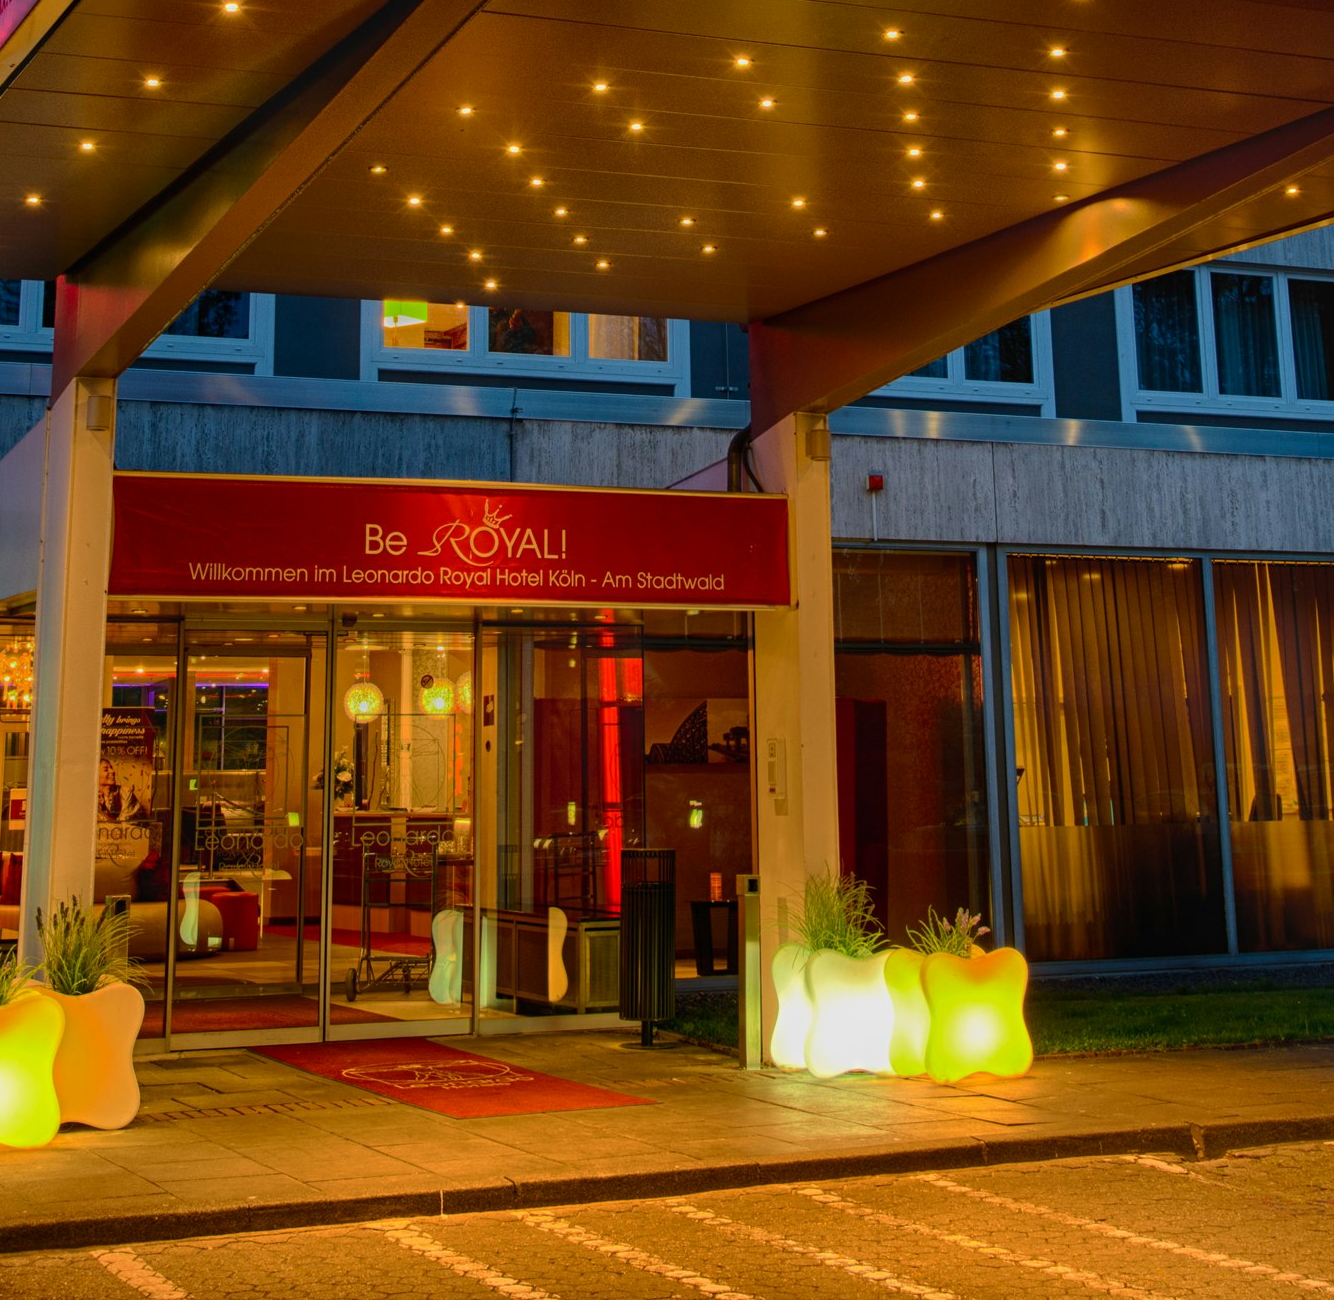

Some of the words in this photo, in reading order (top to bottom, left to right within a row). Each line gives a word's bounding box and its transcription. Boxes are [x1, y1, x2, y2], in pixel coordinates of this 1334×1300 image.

[365, 523, 408, 556] Be
[417, 519, 566, 567] ROYAL!
[188, 562, 308, 582] Willkommen
[314, 565, 336, 583] im
[343, 565, 435, 585] Leonardo
[440, 567, 491, 589] Royal
[496, 568, 544, 587] Hotel
[549, 570, 586, 588] Köln
[601, 571, 632, 589] Am
[637, 571, 725, 590] Stadtwald
